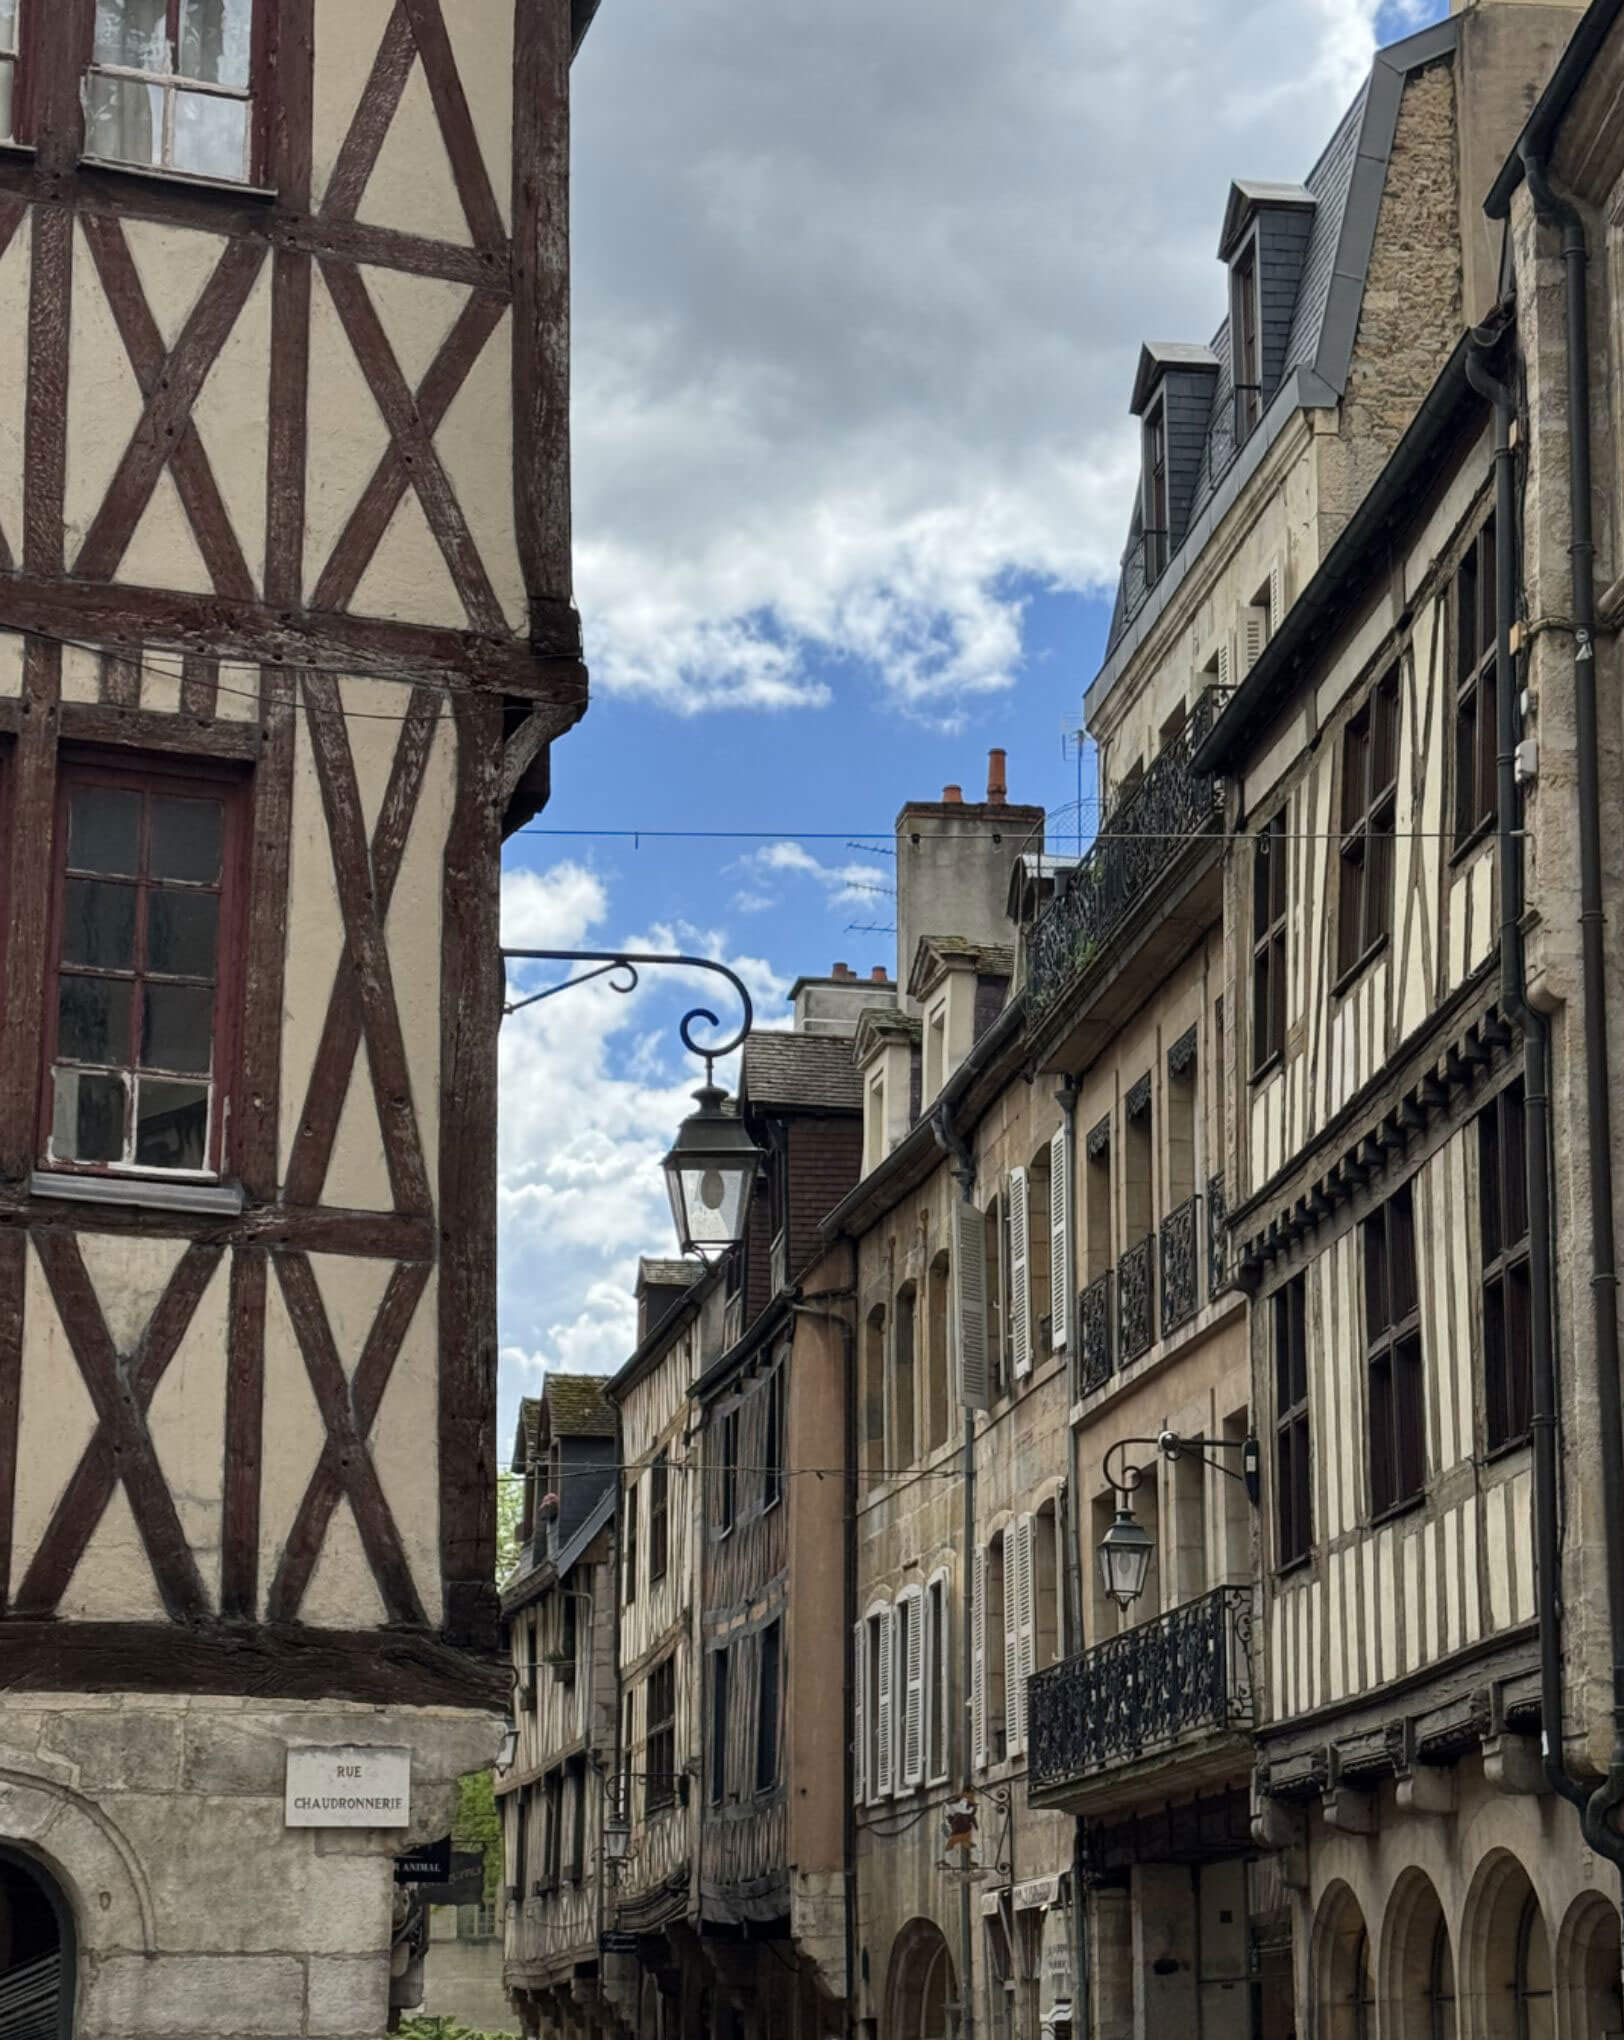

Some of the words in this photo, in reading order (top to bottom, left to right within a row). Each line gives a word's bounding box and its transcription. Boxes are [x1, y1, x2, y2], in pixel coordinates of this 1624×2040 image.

[337, 1765, 362, 1778] RUE
[294, 1797, 403, 1810] CHAUDRONNERIE
[402, 1863, 441, 1873] ANIMAL
